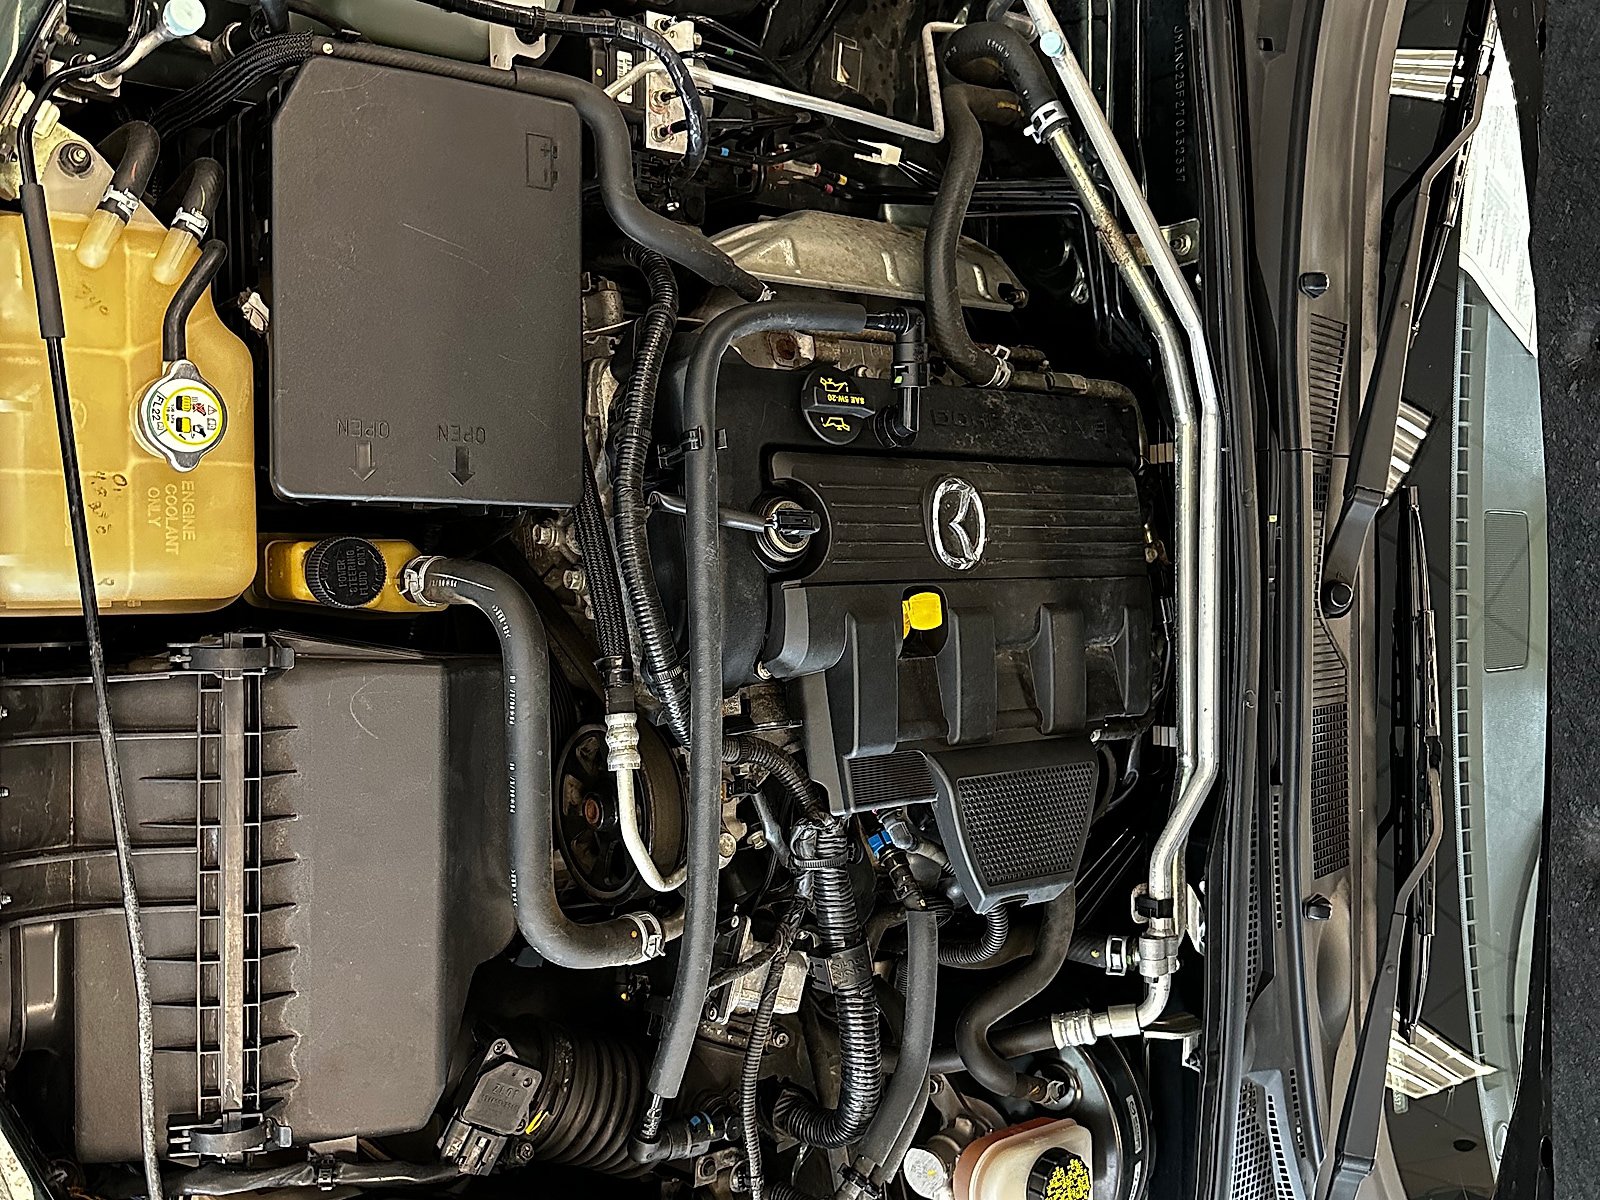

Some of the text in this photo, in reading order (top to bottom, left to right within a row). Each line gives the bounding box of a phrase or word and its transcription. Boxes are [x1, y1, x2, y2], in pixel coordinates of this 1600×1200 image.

[1173, 25, 1186, 183] JM1NC25F270132337
[152, 394, 164, 422] FL22
[827, 393, 866, 405] SAE 5W-20
[336, 418, 390, 440] OPEN
[437, 424, 486, 445] OPEN
[147, 486, 162, 528] ONLY
[164, 483, 179, 556] COOLANT
[181, 480, 196, 542] ENGINE
[336, 559, 348, 588] POWER
[346, 549, 359, 593] STEERING
[356, 545, 369, 596] FLUID ONLY
